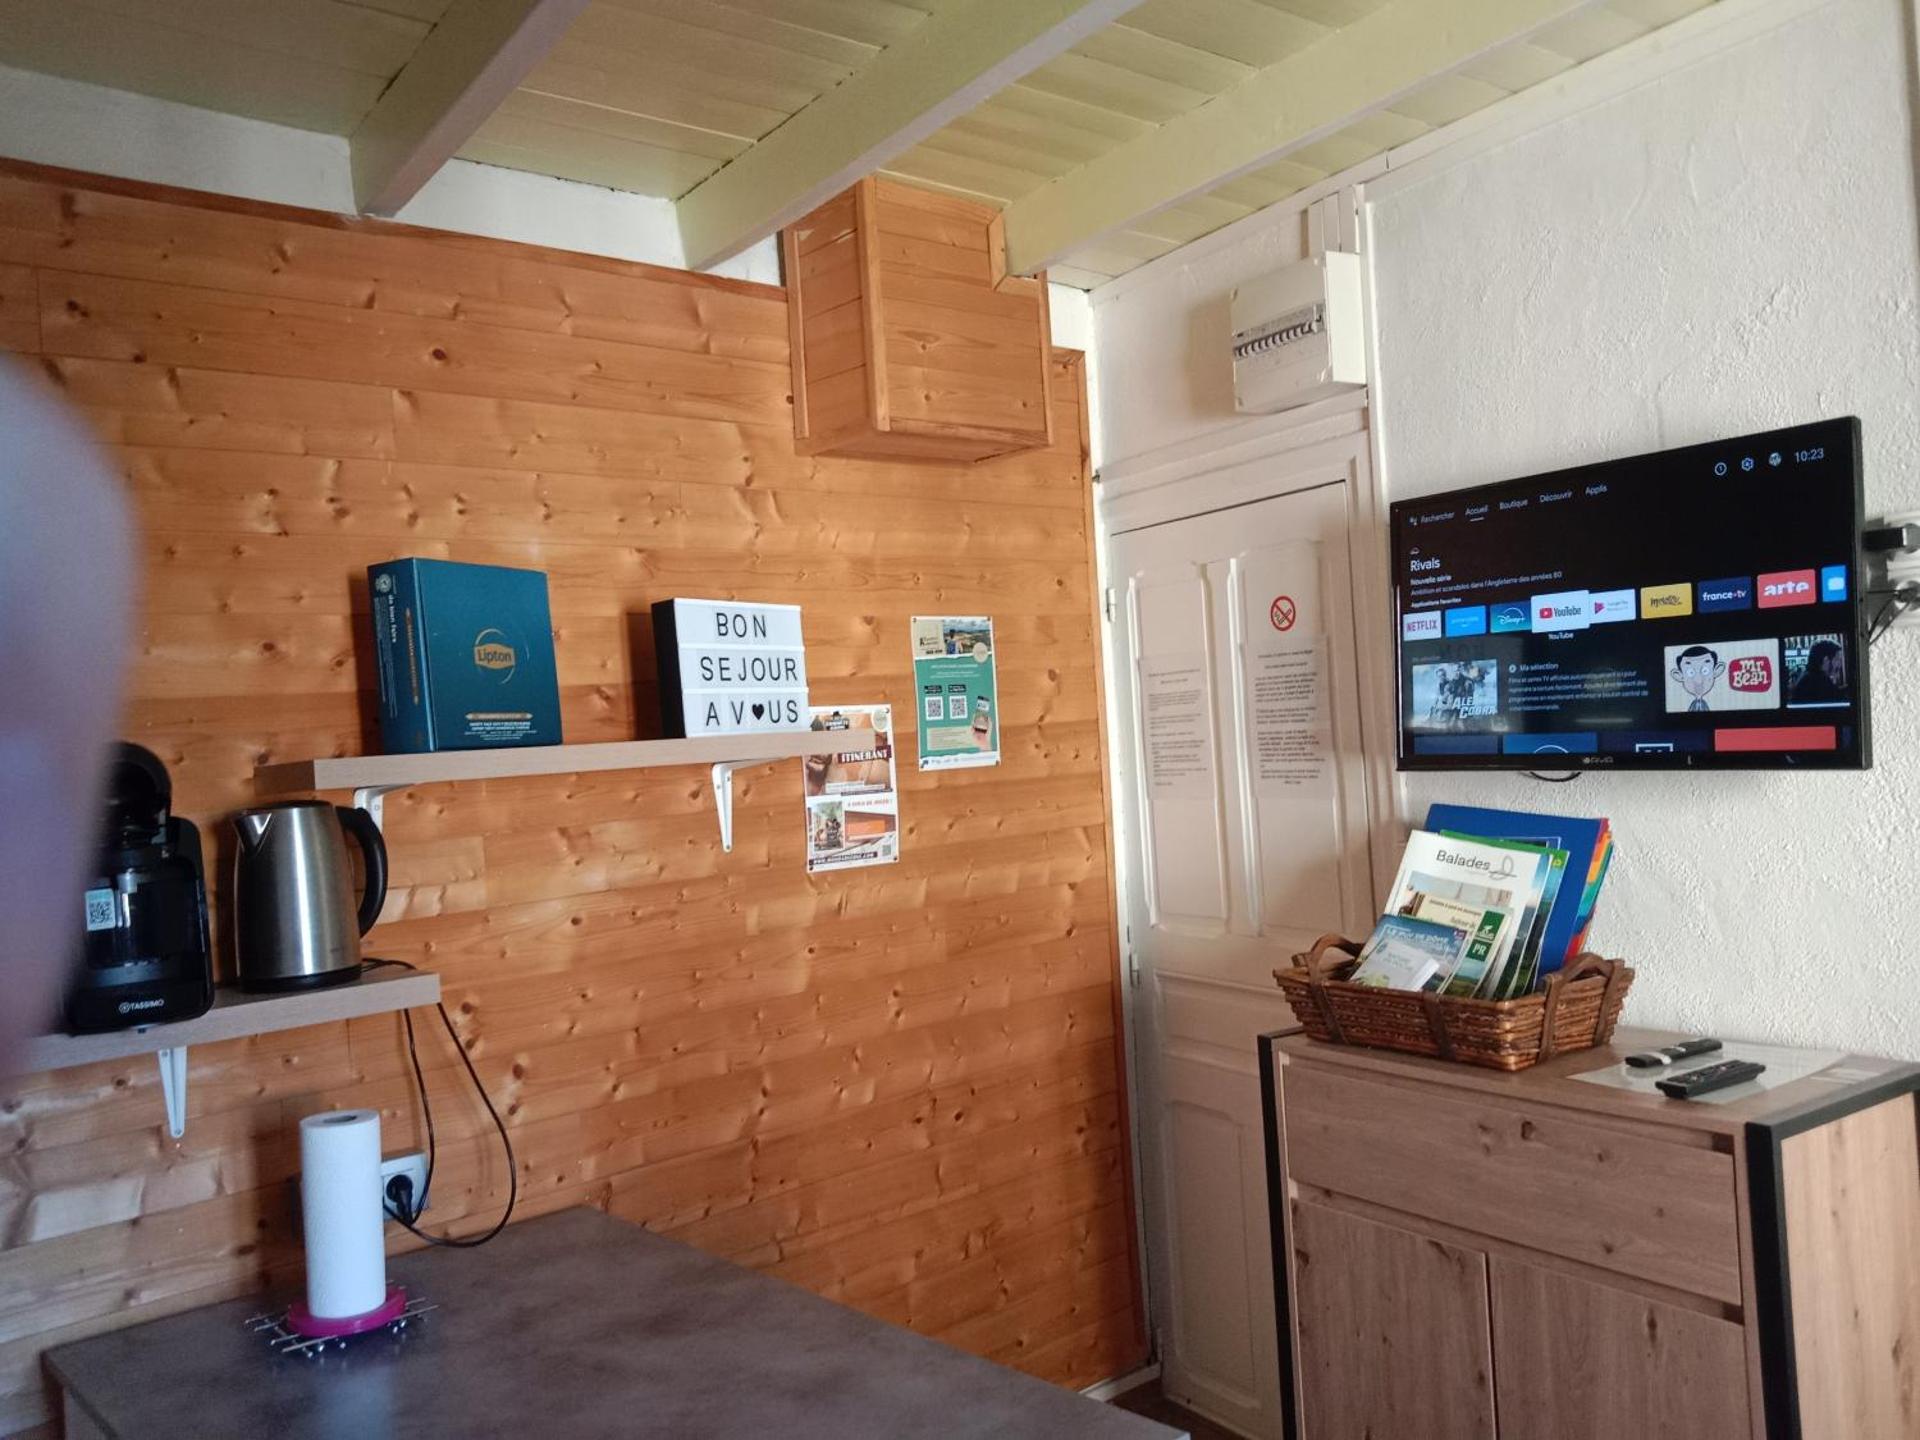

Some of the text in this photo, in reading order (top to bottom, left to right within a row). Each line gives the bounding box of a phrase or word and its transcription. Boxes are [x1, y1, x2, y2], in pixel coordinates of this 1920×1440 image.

[1795, 448, 1824, 463] 10:23
[1420, 483, 1608, 524] Rechercher Accueil Boutique Découvrir Applis
[1410, 557, 1440, 572] Rivals
[1763, 581, 1809, 596] arte
[1553, 605, 1582, 618] YouTube
[716, 612, 767, 638] BON
[1406, 619, 1437, 632] NETFLIX
[1549, 631, 1574, 641] YouTube
[477, 648, 512, 665] Lipton
[700, 656, 798, 681] SEJOUR
[1740, 660, 1765, 673] Mr
[1733, 670, 1769, 688] Bean
[706, 701, 720, 727] A
[1436, 849, 1491, 872] Balades
[1473, 941, 1488, 957] PR
[130, 999, 165, 1011] TASSIMO
